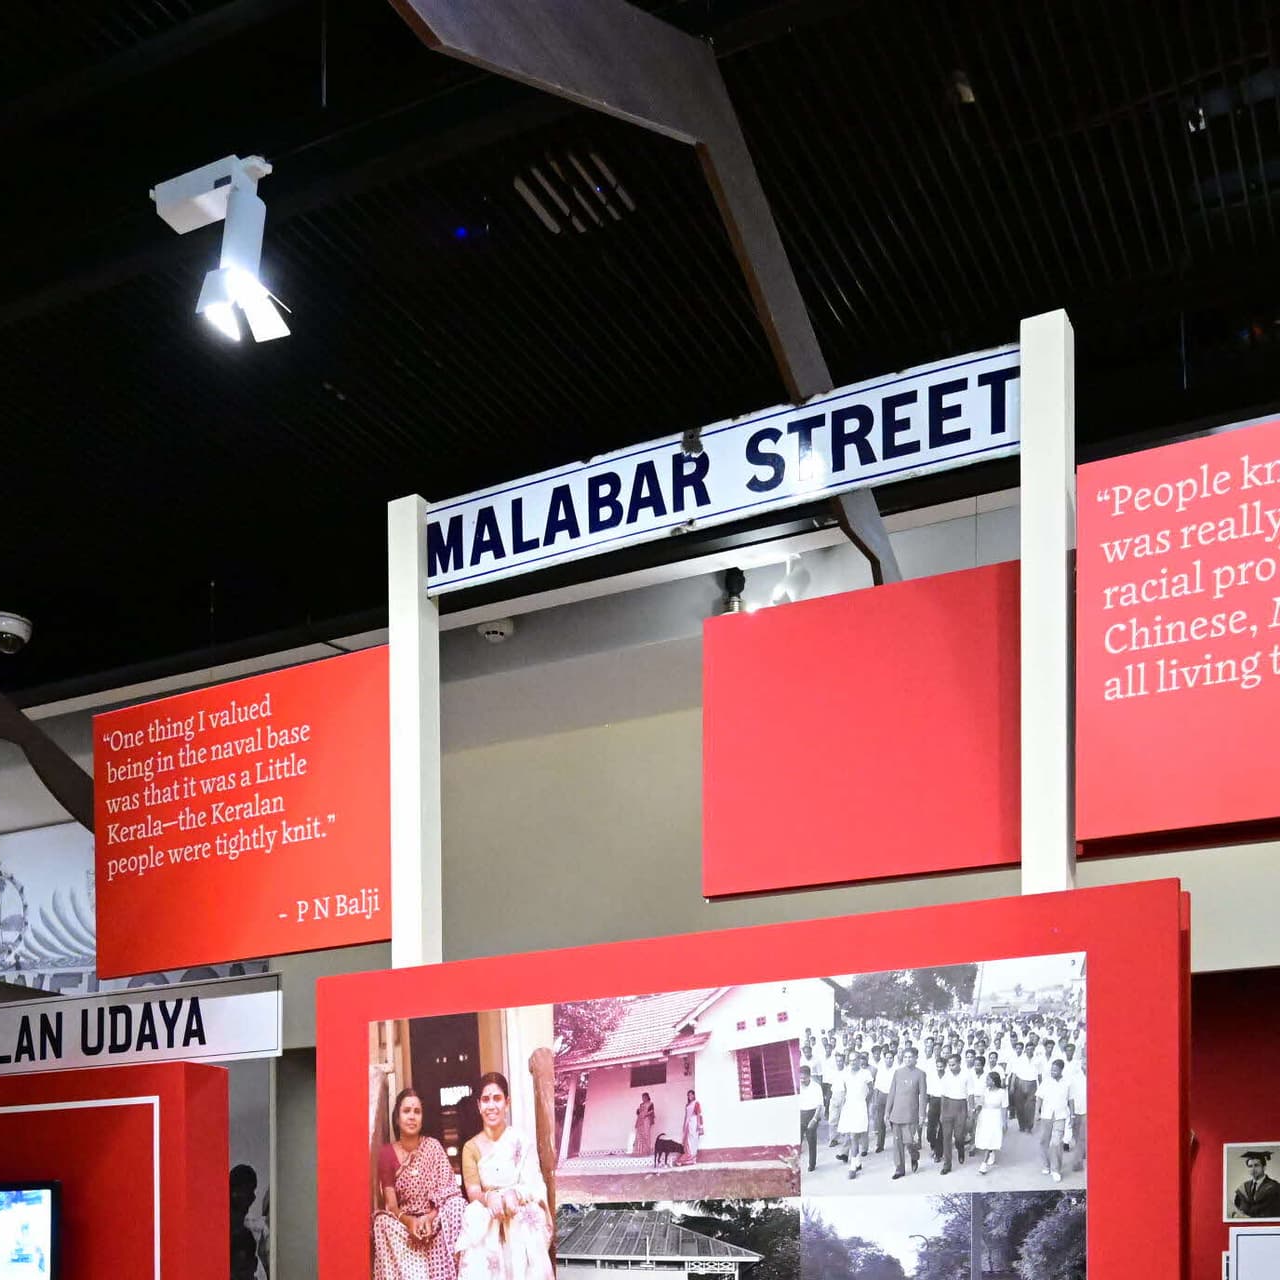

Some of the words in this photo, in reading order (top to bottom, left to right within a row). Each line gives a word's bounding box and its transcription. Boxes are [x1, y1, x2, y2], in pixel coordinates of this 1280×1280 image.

[428, 452, 710, 578] MALABAR
[746, 366, 1019, 492] STREET
[1097, 464, 1230, 516] “People
[1100, 530, 1170, 562] was
[1104, 560, 1204, 609] racial
[1105, 610, 1257, 654] Chinese,
[1104, 662, 1149, 700] all
[1157, 652, 1261, 692] living
[103, 731, 144, 751] “One
[148, 716, 194, 743] thing
[198, 711, 205, 731] I
[209, 693, 272, 728] valued
[107, 757, 154, 783] being
[157, 752, 174, 772] in
[178, 744, 207, 767] the
[211, 730, 263, 760] naval
[267, 725, 310, 749] base
[107, 794, 139, 813] was
[144, 781, 179, 806] that
[183, 777, 196, 798] it
[200, 773, 236, 794] was
[241, 771, 251, 787] a
[256, 755, 307, 784] Little
[211, 796, 285, 824] Keralan
[108, 846, 164, 881] people
[168, 843, 211, 863] were
[215, 826, 278, 860] tightly
[281, 814, 338, 845] knit.”
[297, 901, 308, 922] P
[314, 896, 330, 919] N
[335, 888, 380, 919] Balji
[81, 997, 205, 1056] UDAYA
